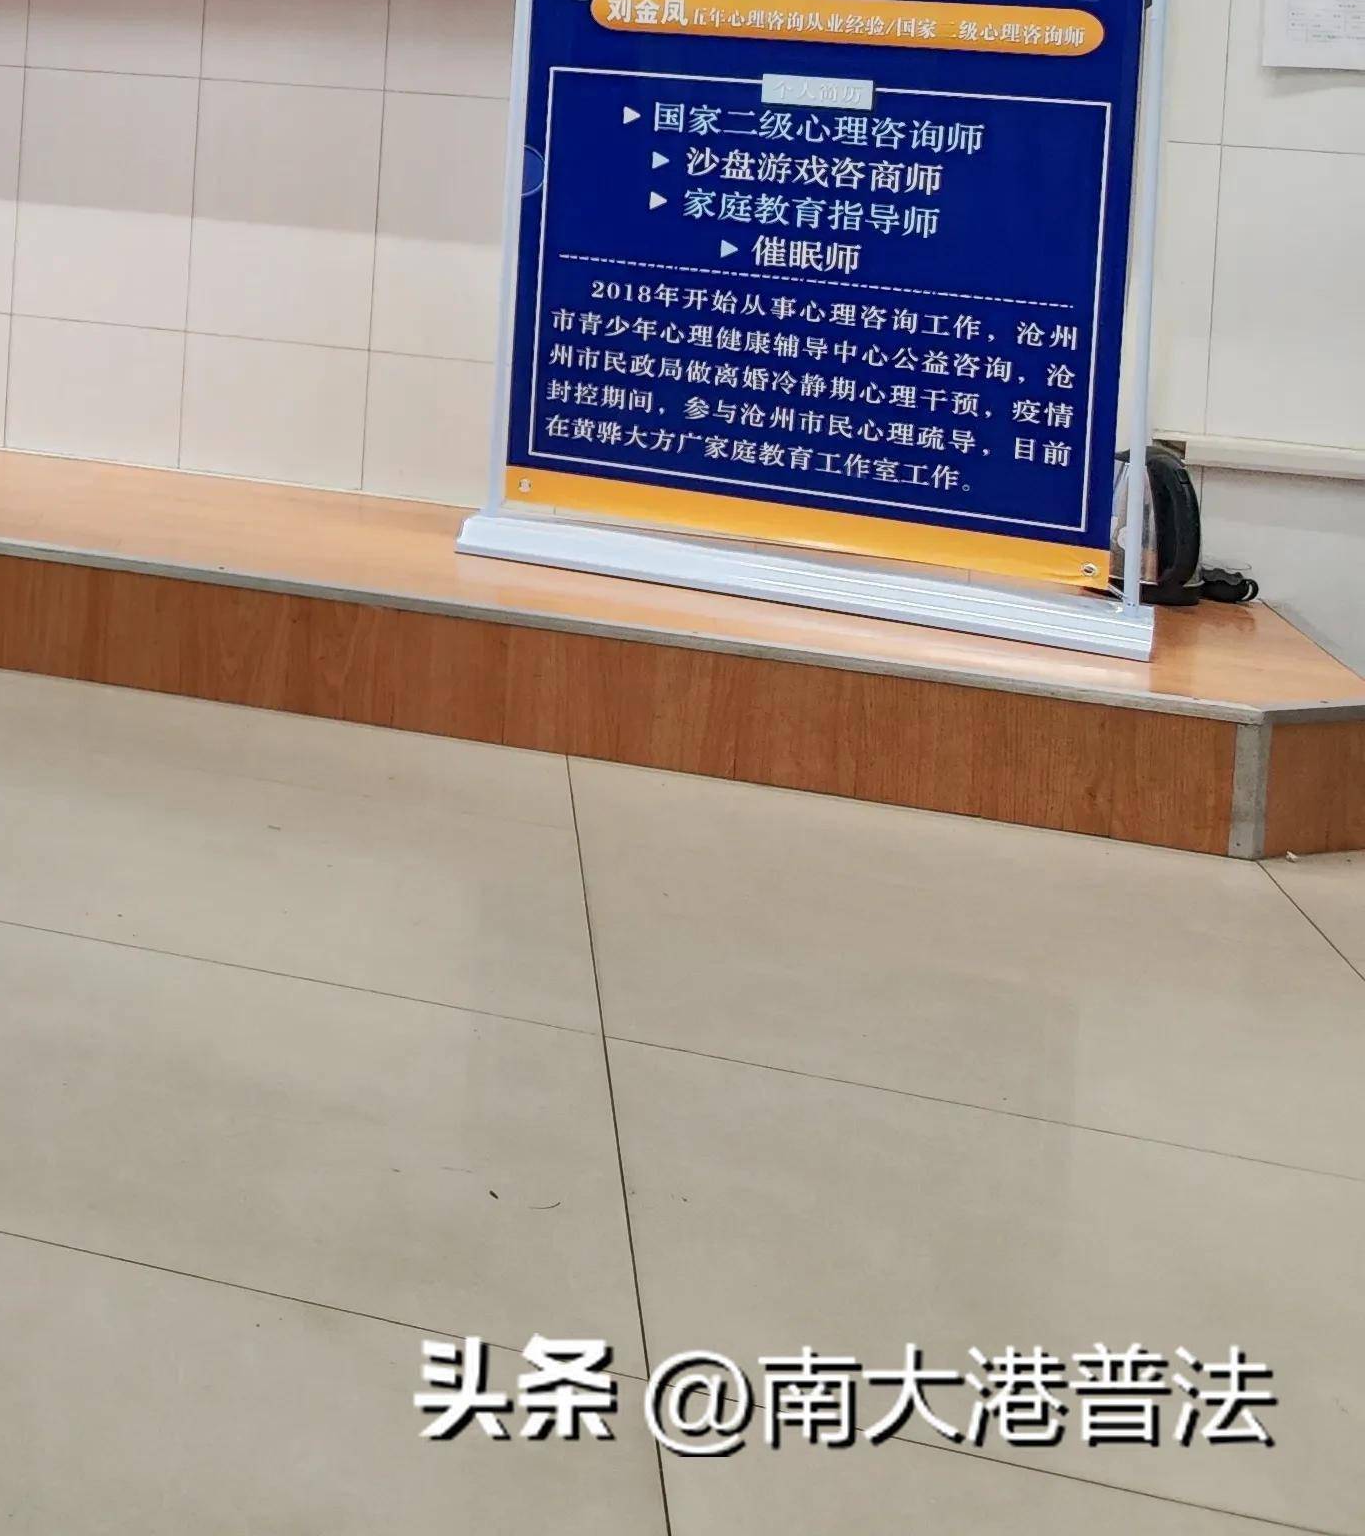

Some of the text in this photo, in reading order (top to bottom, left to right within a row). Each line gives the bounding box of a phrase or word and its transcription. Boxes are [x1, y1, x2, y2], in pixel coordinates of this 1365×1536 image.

[653, 100, 985, 155] 国家二级心理咨询师
[685, 146, 944, 196] 沙盘游戏咨商师
[681, 187, 941, 239] 家庭教育指导师
[750, 234, 863, 275] 催眠师
[590, 279, 1079, 351] 2018年开始从事心理咨询工作，沧州
[549, 307, 1077, 390] 市青少年心理健康辅导中心公益咨询，沧
[548, 343, 1075, 430] 州市民政局做离婚冷静期心理干预，疫情
[544, 413, 971, 492] 在黄骅大方广家庭教育工作室工作。
